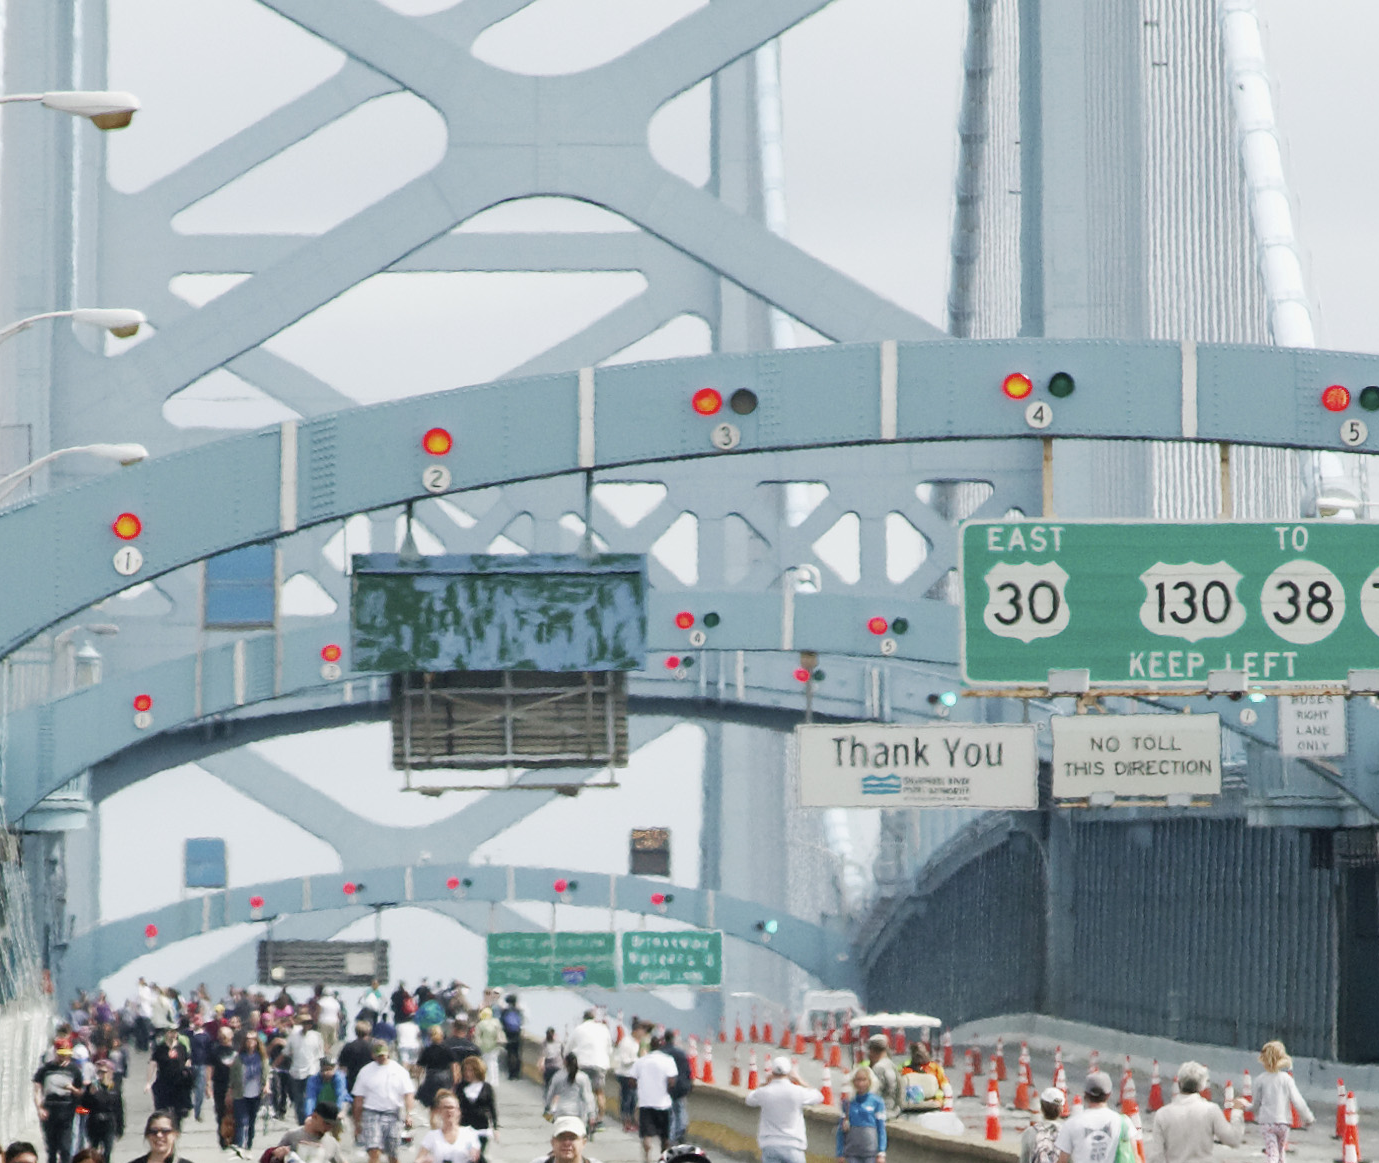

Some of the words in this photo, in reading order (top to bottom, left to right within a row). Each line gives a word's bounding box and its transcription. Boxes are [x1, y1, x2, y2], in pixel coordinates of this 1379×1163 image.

[987, 526, 1065, 552] EAST
[1274, 526, 1310, 553] TO
[993, 581, 1061, 625] 30
[1155, 581, 1232, 625] 130
[1273, 580, 1335, 625] 38
[1129, 651, 1205, 678] KEEP
[1296, 710, 1330, 721] RIGHT
[1296, 725, 1331, 736] LANE
[831, 734, 930, 768] Thank
[943, 736, 1004, 768] You
[1090, 736, 1121, 753] NO
[1132, 735, 1182, 751] TOLL
[1297, 741, 1330, 751] ONLY
[1064, 761, 1105, 777] THIS
[1115, 760, 1212, 777] DIRECTION
